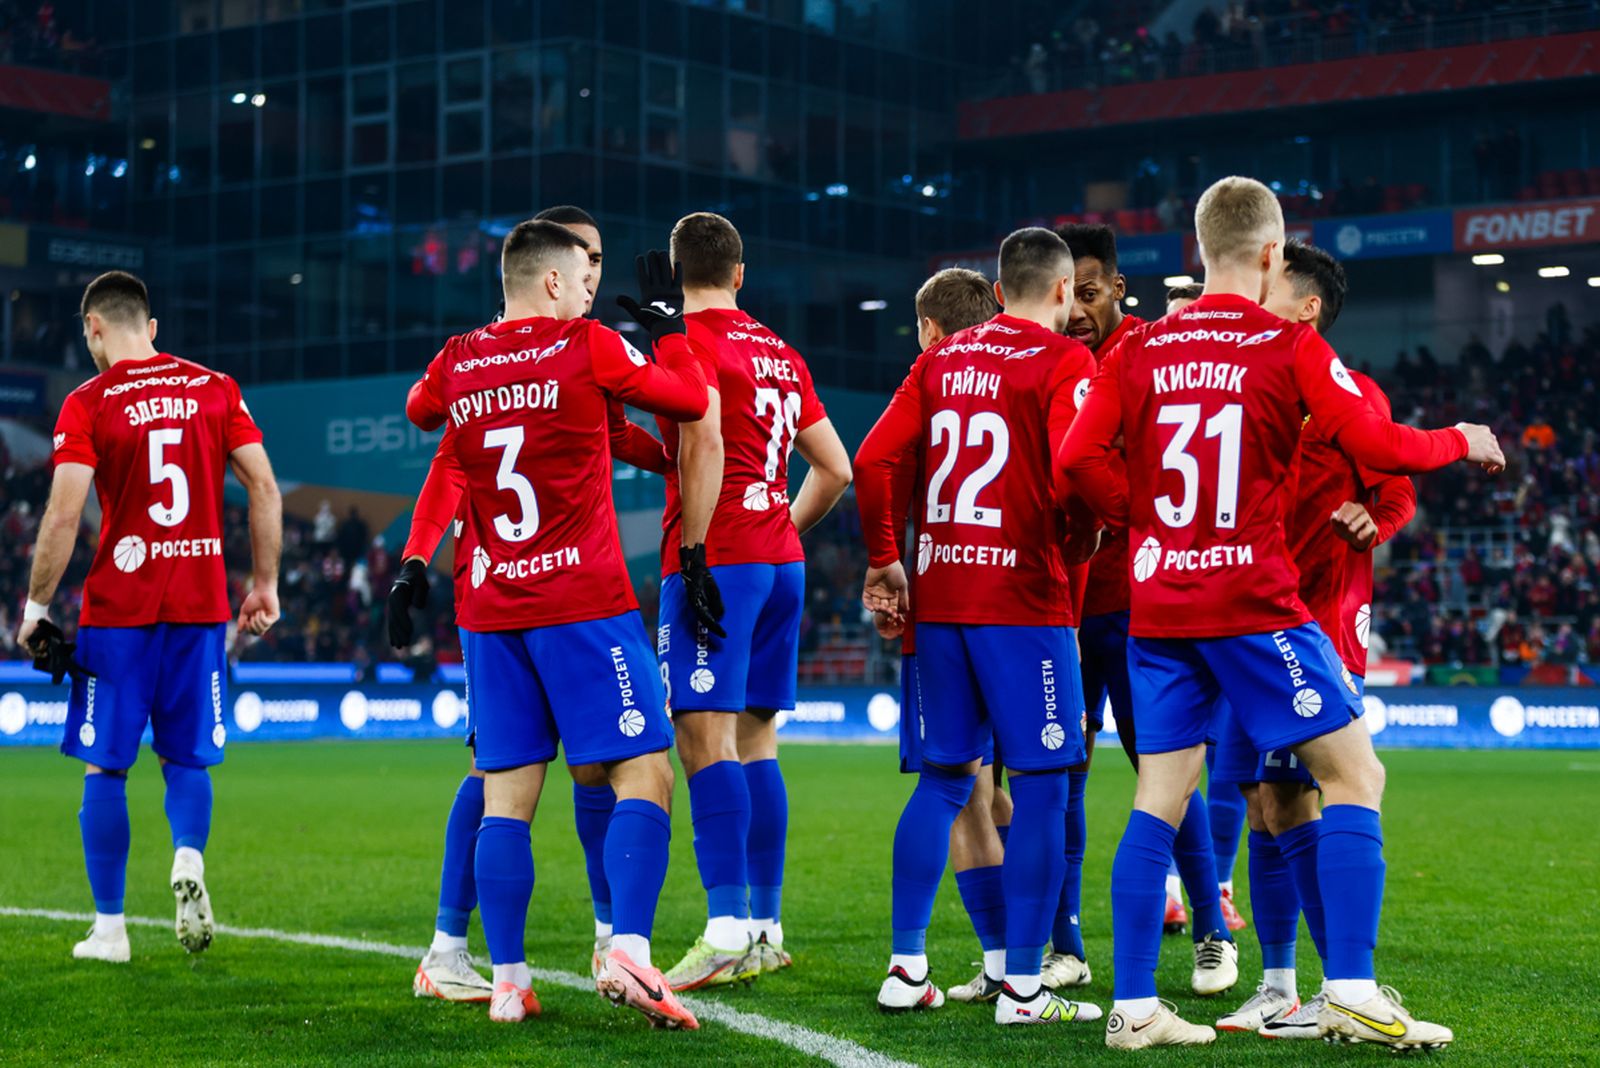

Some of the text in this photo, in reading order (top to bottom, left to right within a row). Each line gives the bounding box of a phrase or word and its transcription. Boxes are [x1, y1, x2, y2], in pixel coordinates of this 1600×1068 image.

[1464, 206, 1595, 246] FONBET
[935, 342, 1016, 358] АЭРОФЛОТ
[1144, 329, 1247, 348] АЭРОФЛОТ
[453, 347, 540, 374] АЭРОФЛОТ
[103, 375, 189, 399] АЭРОФЛОТ
[942, 365, 1001, 400] ГАЙИЧ
[1153, 361, 1248, 395] КИСЛЯК
[124, 397, 199, 427] ЗДЕЛАР
[449, 379, 559, 428] КРУГОВОЙ
[147, 428, 190, 527] 5
[926, 409, 1010, 528] 22
[1154, 403, 1243, 529] 31
[483, 425, 540, 543] 3
[151, 537, 222, 560] РОССЕТИ
[492, 547, 581, 580] РОССЕТИ
[933, 543, 1017, 568] РОССЕТИ
[1163, 544, 1253, 571] РОССЕТИ
[610, 646, 635, 707] РОССЕТИ
[1041, 659, 1057, 720] РОССЕТИ
